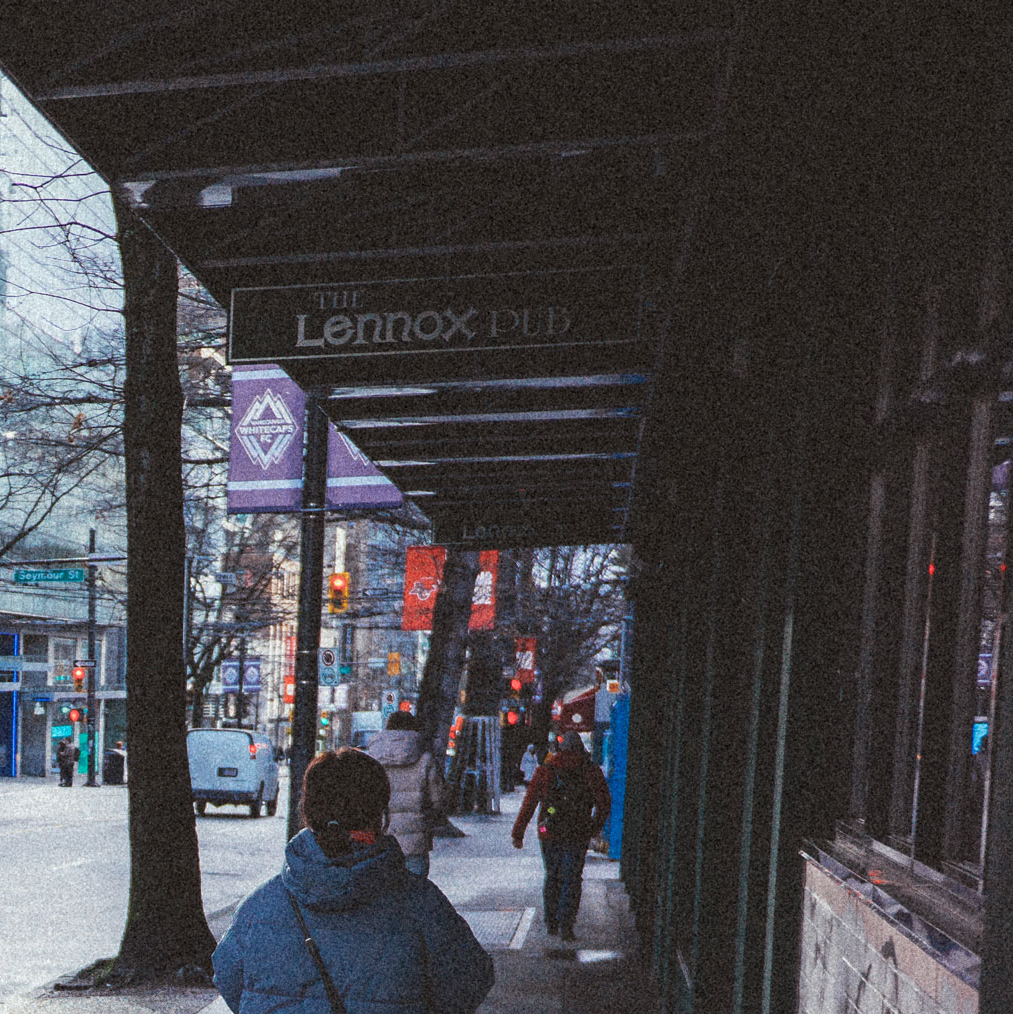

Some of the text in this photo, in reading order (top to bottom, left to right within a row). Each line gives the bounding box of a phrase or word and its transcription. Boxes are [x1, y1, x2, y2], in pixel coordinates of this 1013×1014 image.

[315, 291, 364, 309] THE
[295, 307, 478, 348] Lennox
[239, 425, 294, 435] WHITECAPS
[260, 434, 273, 443] FC
[19, 570, 80, 581] Seymour St
